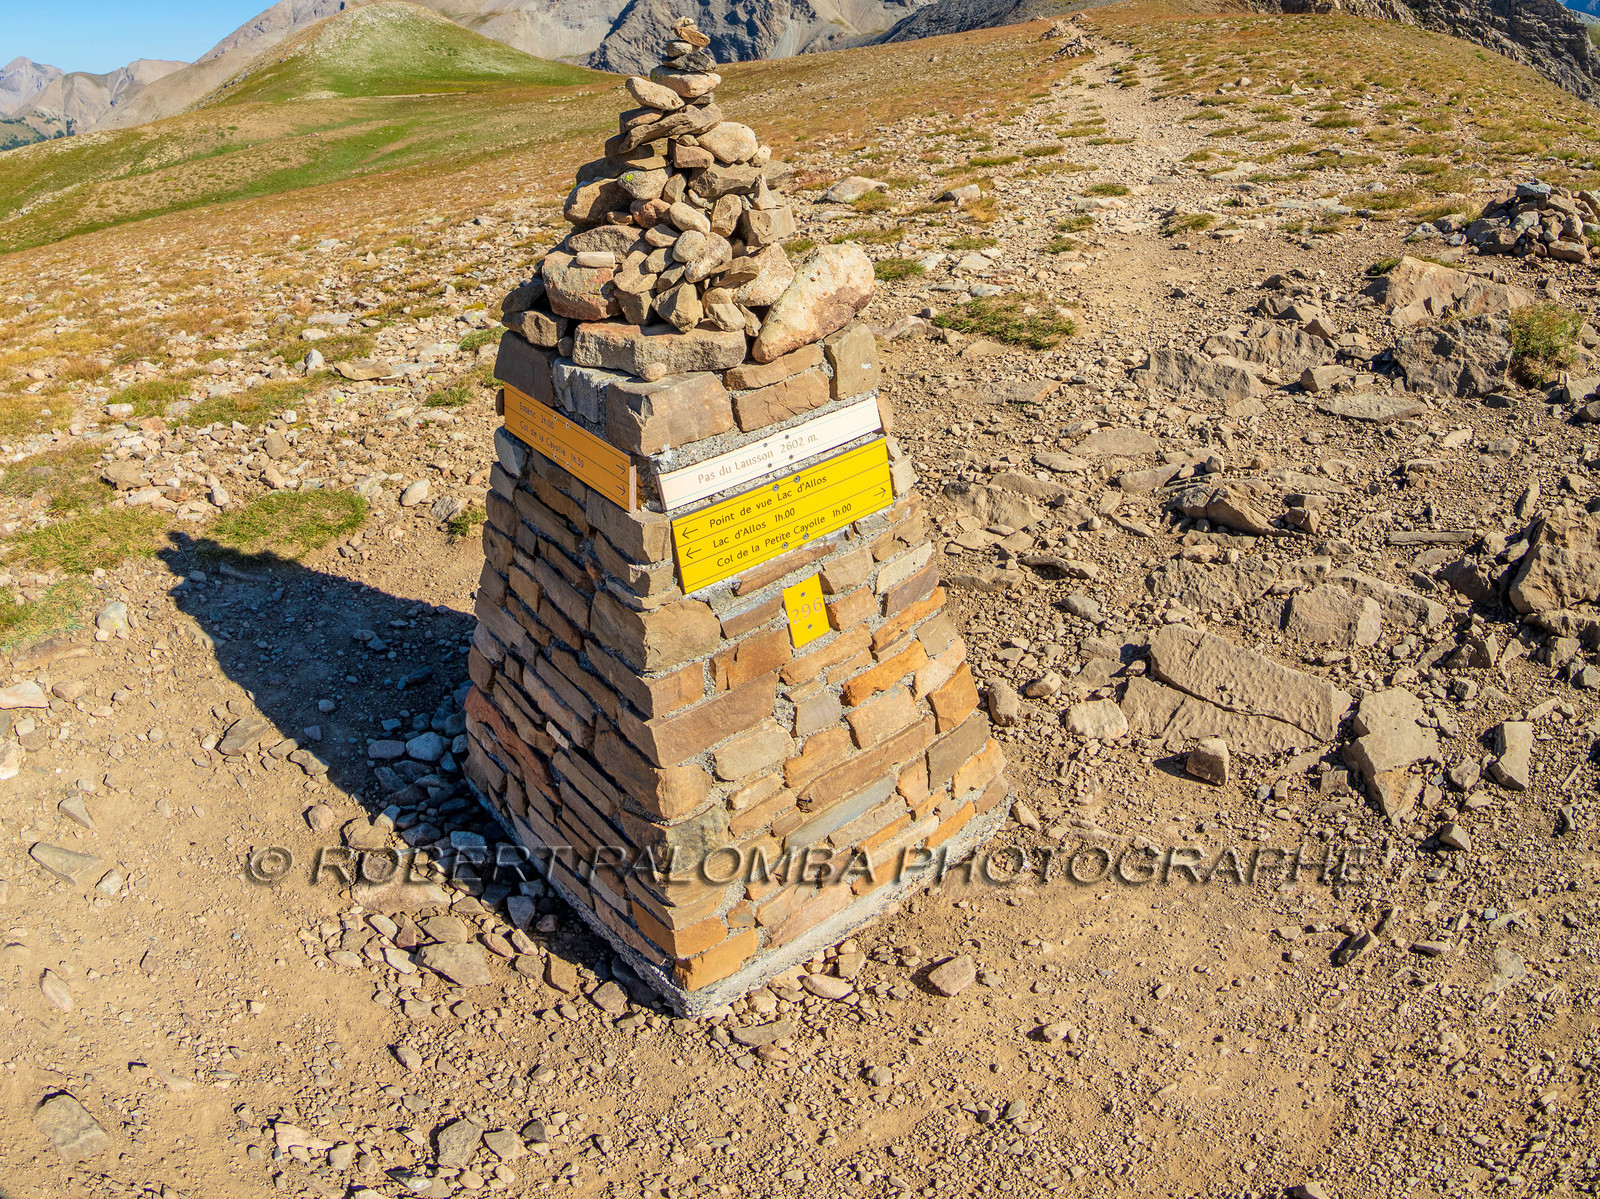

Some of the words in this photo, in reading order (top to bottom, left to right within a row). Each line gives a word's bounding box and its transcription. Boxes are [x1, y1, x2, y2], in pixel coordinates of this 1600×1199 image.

[520, 402, 536, 418] Estenc
[520, 421, 528, 431] Col
[531, 430, 537, 438] de
[540, 432, 544, 442] la
[546, 438, 566, 456] Cayolle
[698, 471, 715, 484] Pas
[719, 466, 731, 476] du
[735, 450, 773, 471] Lausson
[780, 437, 804, 454] 2602
[709, 512, 735, 528] Point
[740, 505, 752, 517] de
[756, 498, 772, 510] vue
[777, 490, 792, 501] Lac
[797, 475, 827, 493] d'Allos
[713, 535, 729, 548] Lac
[735, 520, 766, 539] d'Allos
[774, 508, 795, 522] 1h.00
[717, 555, 734, 567] Col
[737, 547, 749, 558] de
[752, 542, 759, 552] la
[765, 531, 791, 547] Petite
[793, 515, 826, 536] Cayolle
[832, 503, 852, 518] 1h.00
[791, 599, 822, 624] 296
